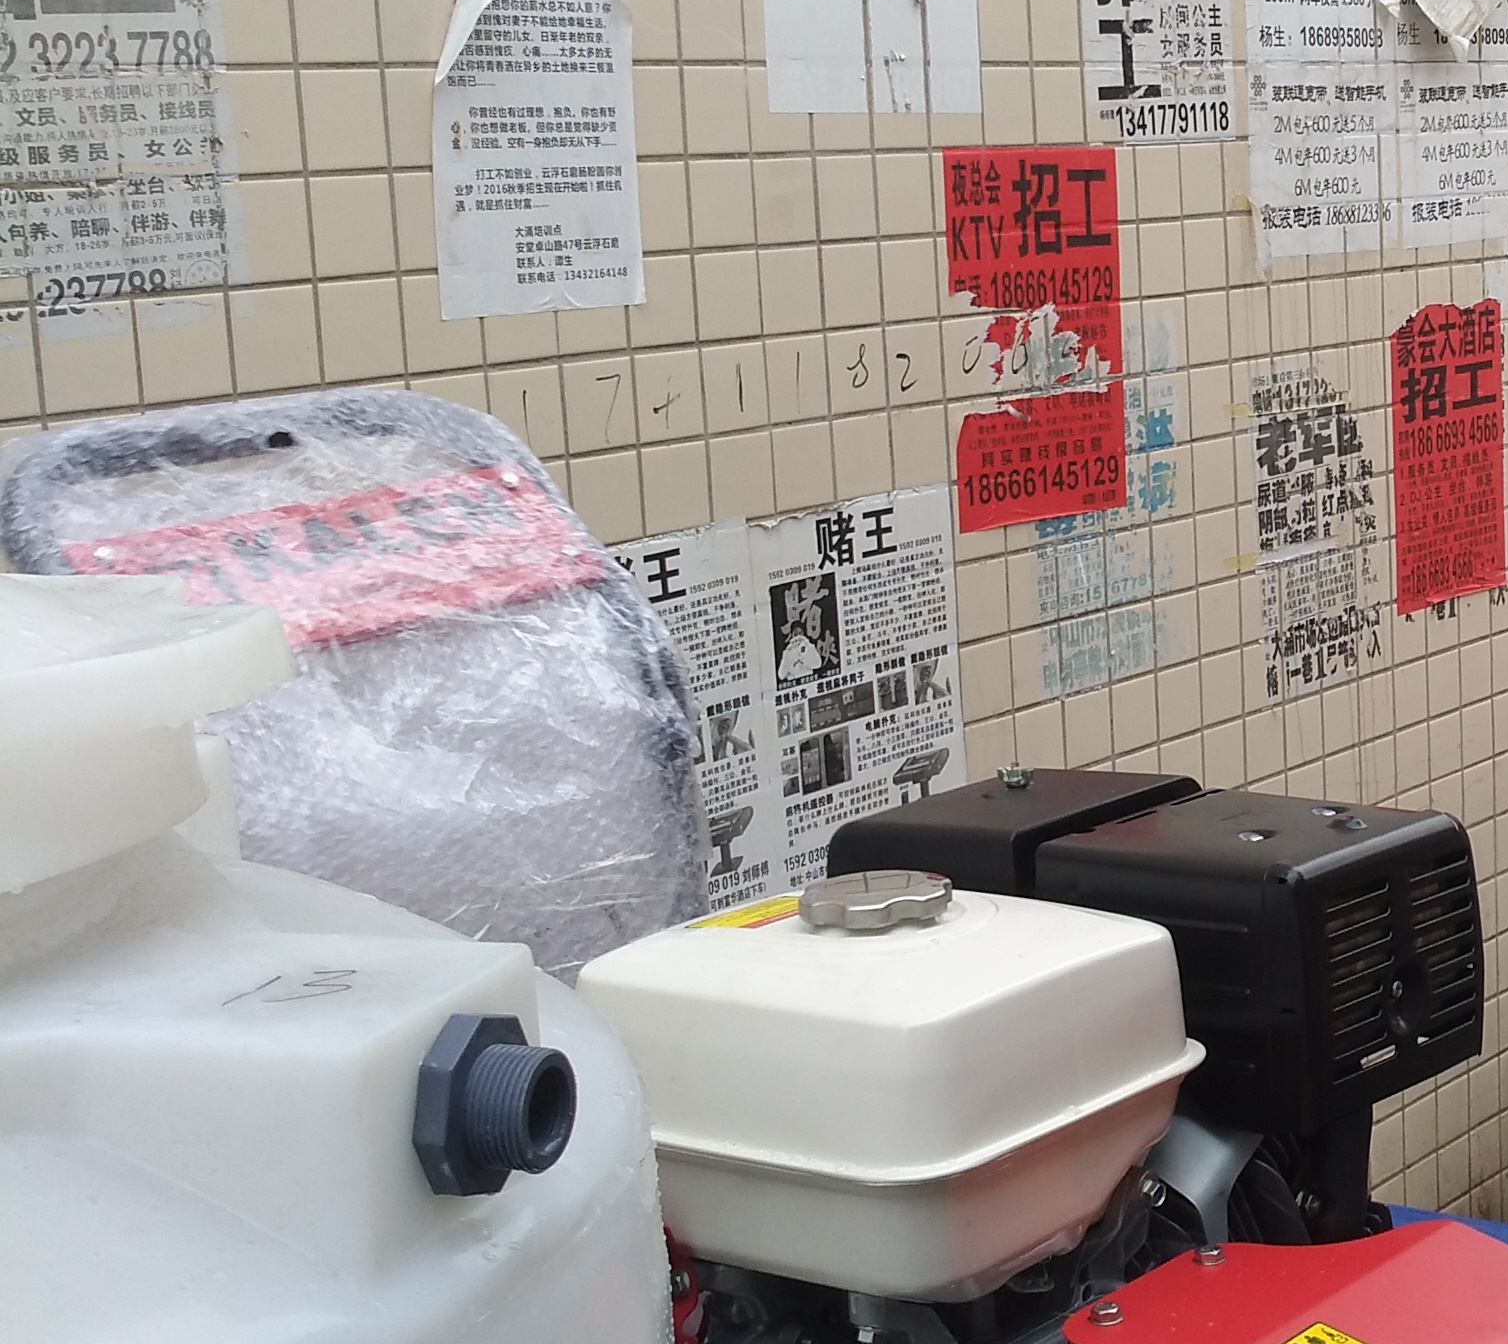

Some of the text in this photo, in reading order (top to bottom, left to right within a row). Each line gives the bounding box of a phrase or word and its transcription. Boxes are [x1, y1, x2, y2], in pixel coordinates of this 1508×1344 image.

[1115, 101, 1230, 138] 13417791118
[951, 159, 1001, 206] 夜总会
[1012, 159, 1111, 258] 招工
[951, 215, 1005, 262] KTV
[1400, 359, 1498, 424] 招工
[1410, 425, 1433, 458] 186
[1468, 412, 1499, 446] 4566
[963, 454, 1120, 507] 18666145129
[815, 506, 898, 570] 赌王
[784, 852, 807, 873] 1592
